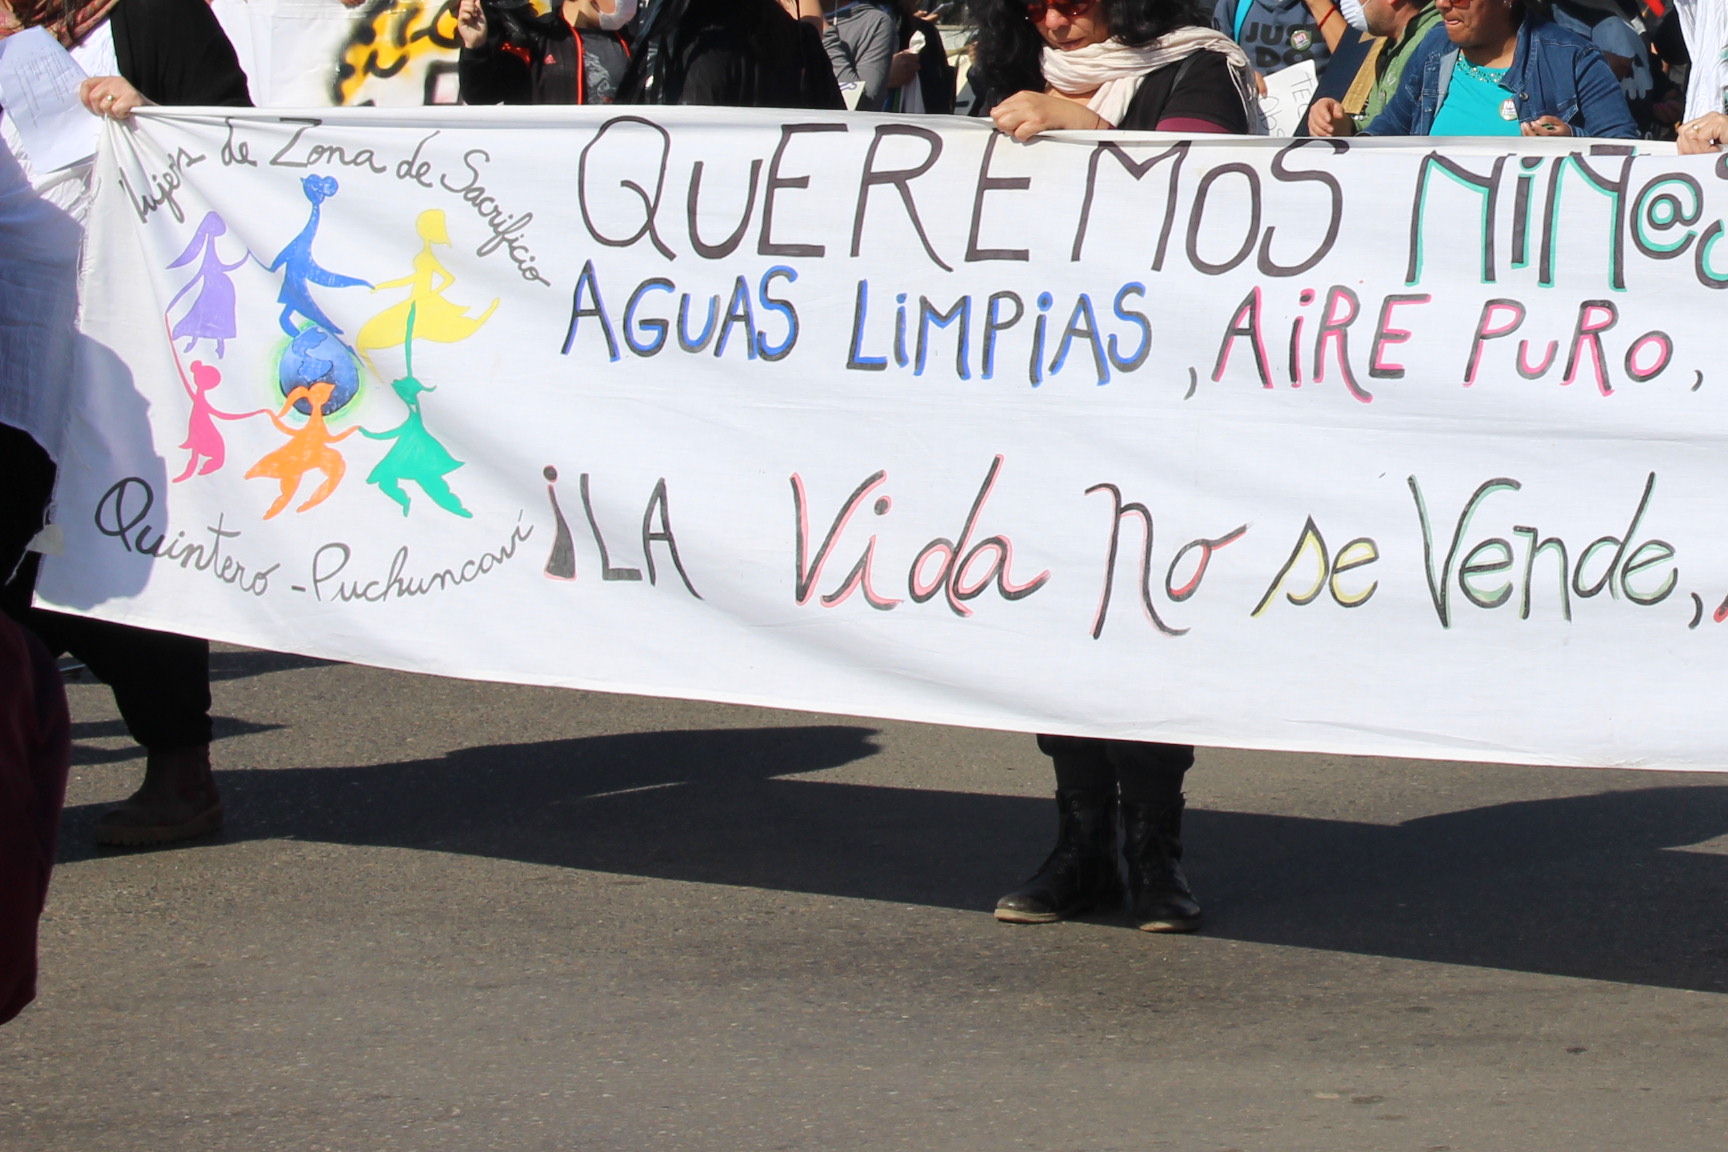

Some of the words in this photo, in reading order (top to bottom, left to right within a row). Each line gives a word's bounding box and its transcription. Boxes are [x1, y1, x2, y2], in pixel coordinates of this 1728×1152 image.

[221, 116, 258, 167] de
[270, 117, 387, 173] Zona
[396, 130, 442, 188] de
[440, 149, 552, 287] Sacrificio
[578, 116, 1350, 278] QUEREMOS
[562, 259, 801, 363] AGUAS
[94, 476, 281, 598] Quintero
[789, 453, 1051, 619] Vida
[1248, 513, 1380, 619] se
[1406, 471, 1703, 630] Vende,
